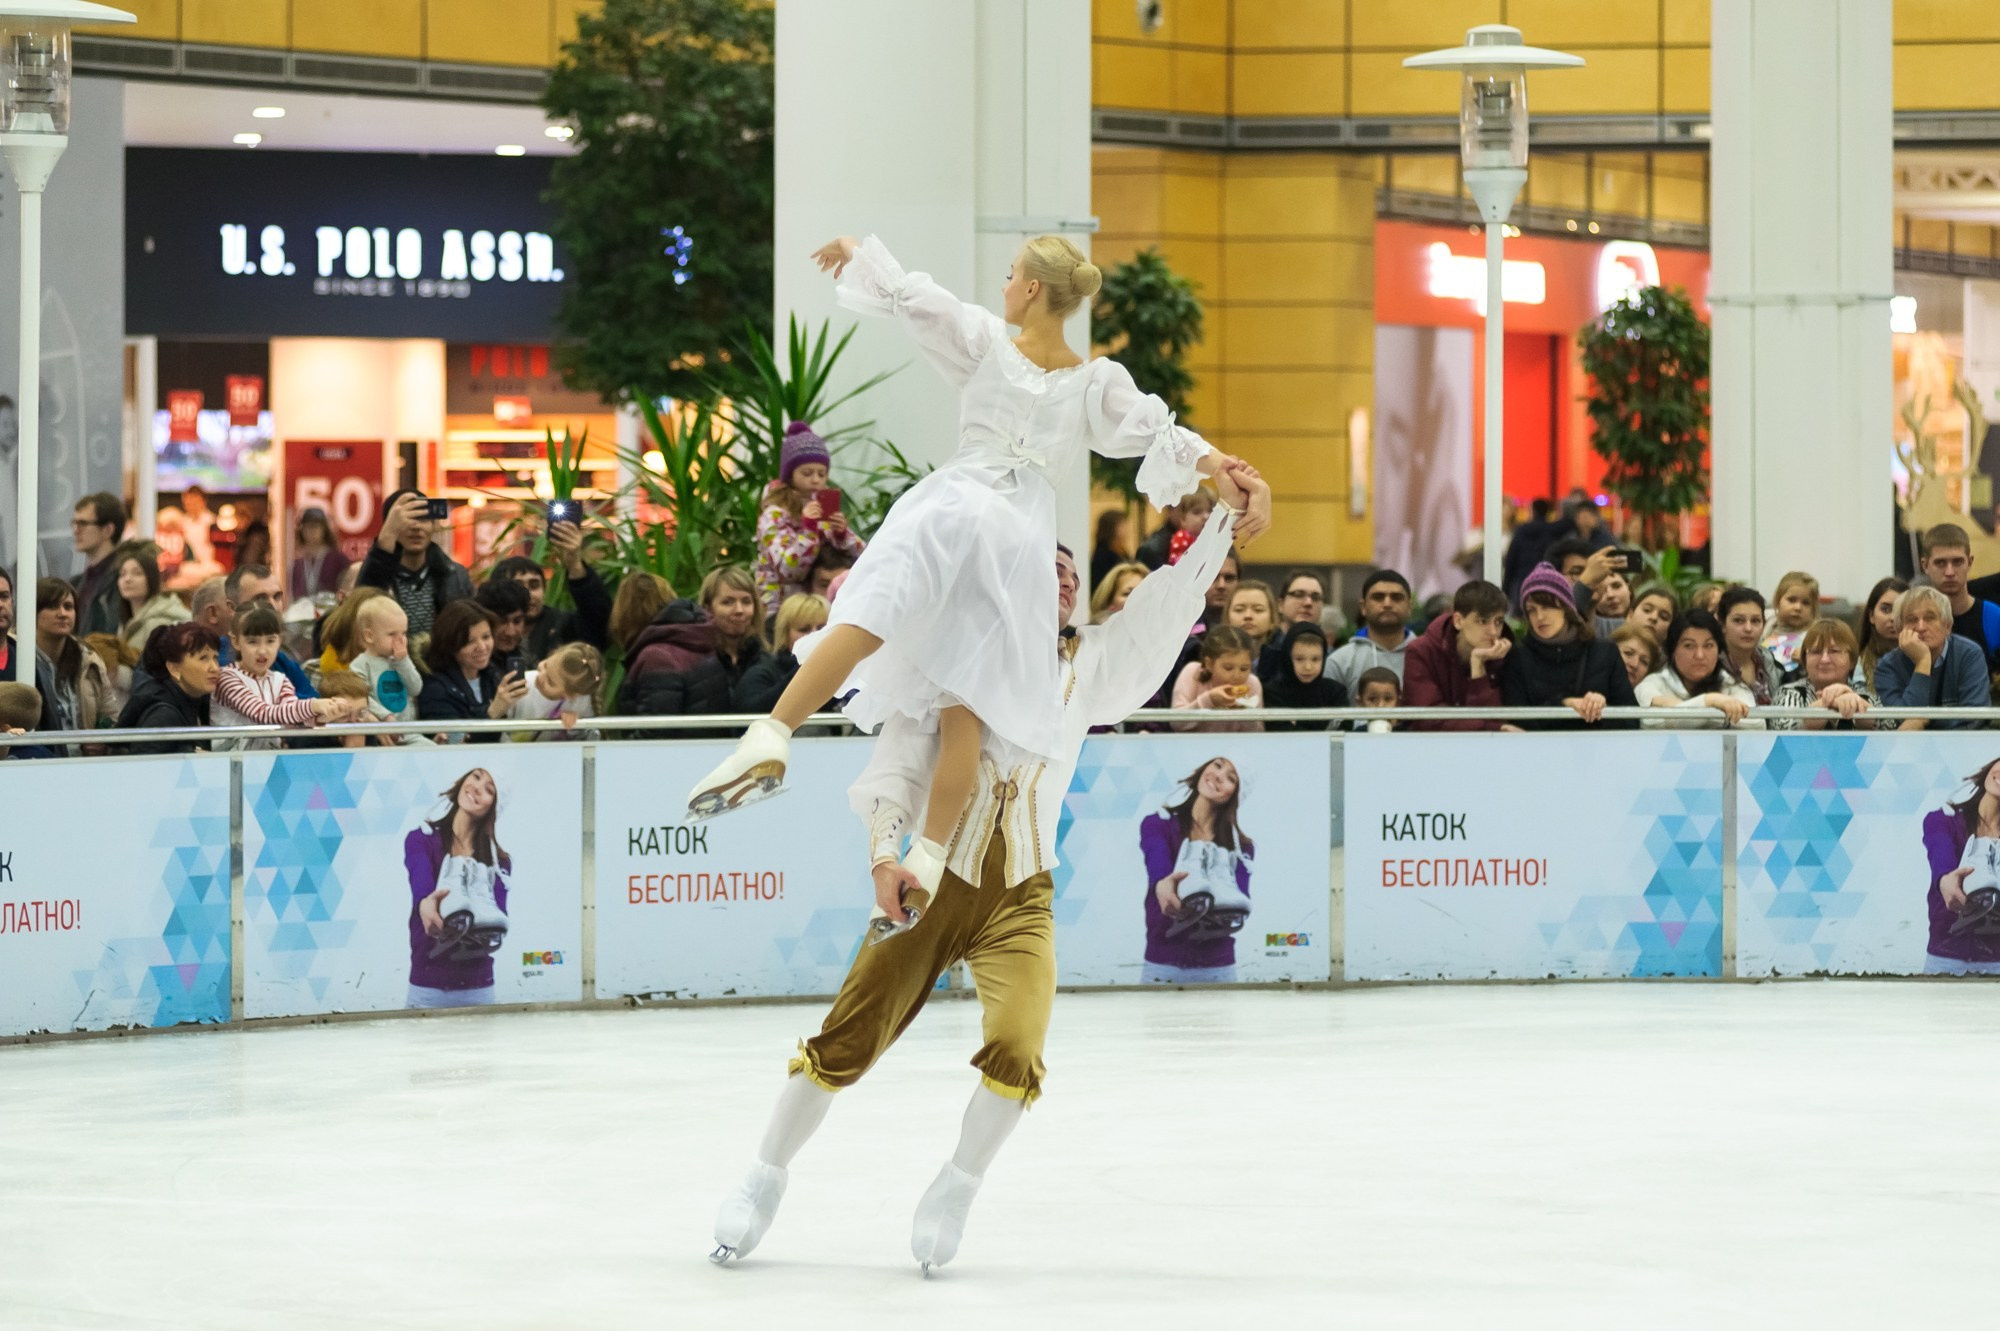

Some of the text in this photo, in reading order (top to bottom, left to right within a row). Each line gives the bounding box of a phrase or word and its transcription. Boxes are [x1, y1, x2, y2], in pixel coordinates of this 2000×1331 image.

[220, 224, 565, 282] U.S. POLO ASSN.
[313, 278, 395, 296] SINCE
[629, 825, 708, 856] КАТОК
[1382, 813, 1466, 841] КАТОК
[629, 871, 783, 904] БЕСПЛАТНО!
[1382, 858, 1547, 887] БЕСПЛАТНО!
